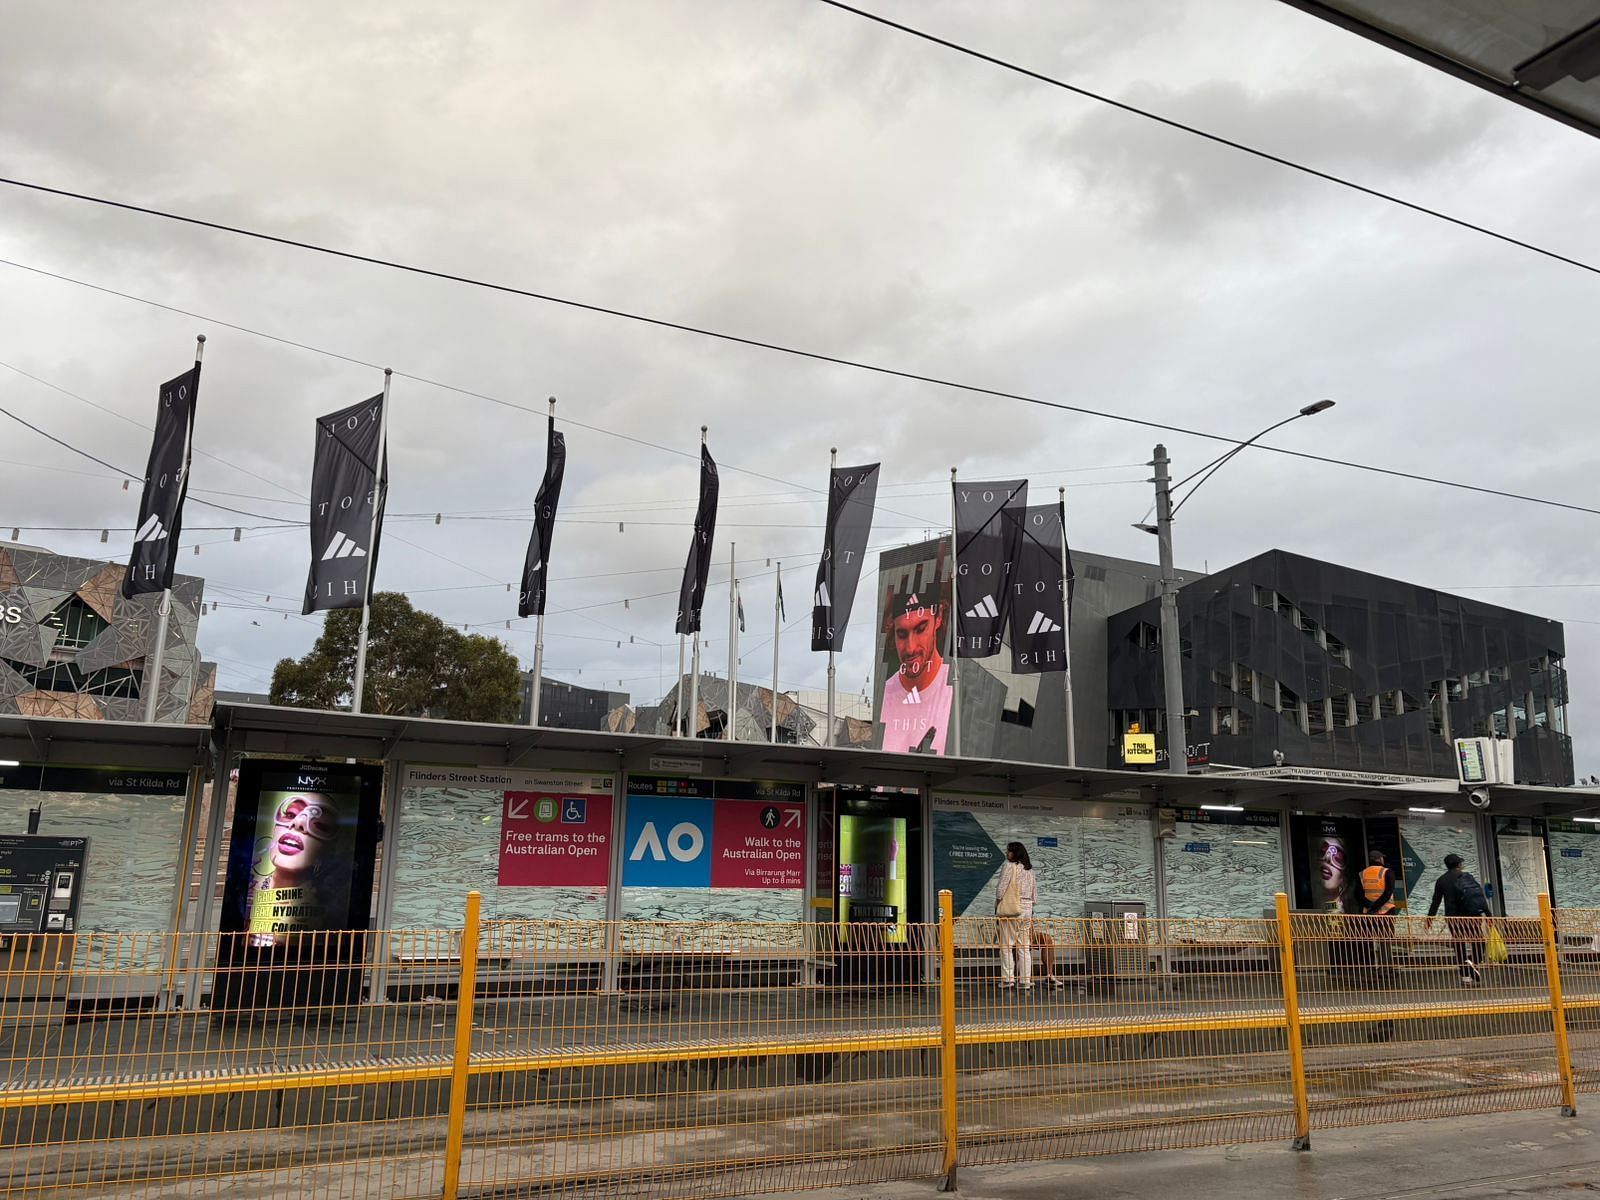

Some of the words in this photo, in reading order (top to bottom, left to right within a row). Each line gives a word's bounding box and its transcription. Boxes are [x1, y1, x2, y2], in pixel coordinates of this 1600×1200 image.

[961, 489, 1017, 503] YOU
[958, 561, 1013, 576] GOT
[905, 603, 938, 620] YOU
[956, 632, 1002, 649] THIS
[899, 660, 934, 675] GOT
[893, 718, 928, 731] THIS
[409, 771, 446, 782] Flinders
[448, 773, 478, 782] Street
[479, 774, 512, 784] Station
[1291, 768, 1322, 776] TRANSPORT
[108, 777, 123, 787] via
[126, 778, 138, 787] St
[140, 779, 163, 788] Kilda
[166, 779, 180, 789] Rd
[298, 776, 326, 785] NYX
[534, 778, 563, 787] Swanston
[628, 781, 653, 791] Routes
[934, 798, 960, 808] Flinders
[961, 799, 981, 808] Street
[981, 800, 1004, 809] Station
[506, 830, 532, 841] Free
[535, 832, 569, 842] trams
[572, 833, 584, 842] to
[587, 832, 606, 843] the
[744, 836, 770, 847] Walk
[772, 837, 783, 847] to
[785, 838, 801, 848] the
[504, 843, 565, 855] Australian
[568, 844, 598, 858] Open
[722, 847, 773, 859] Australian
[775, 849, 801, 861] Open
[744, 868, 755, 876] Via
[756, 868, 786, 878] Birrarung
[786, 869, 801, 877] Marr
[762, 876, 771, 885] Up
[275, 888, 304, 901] SHINE
